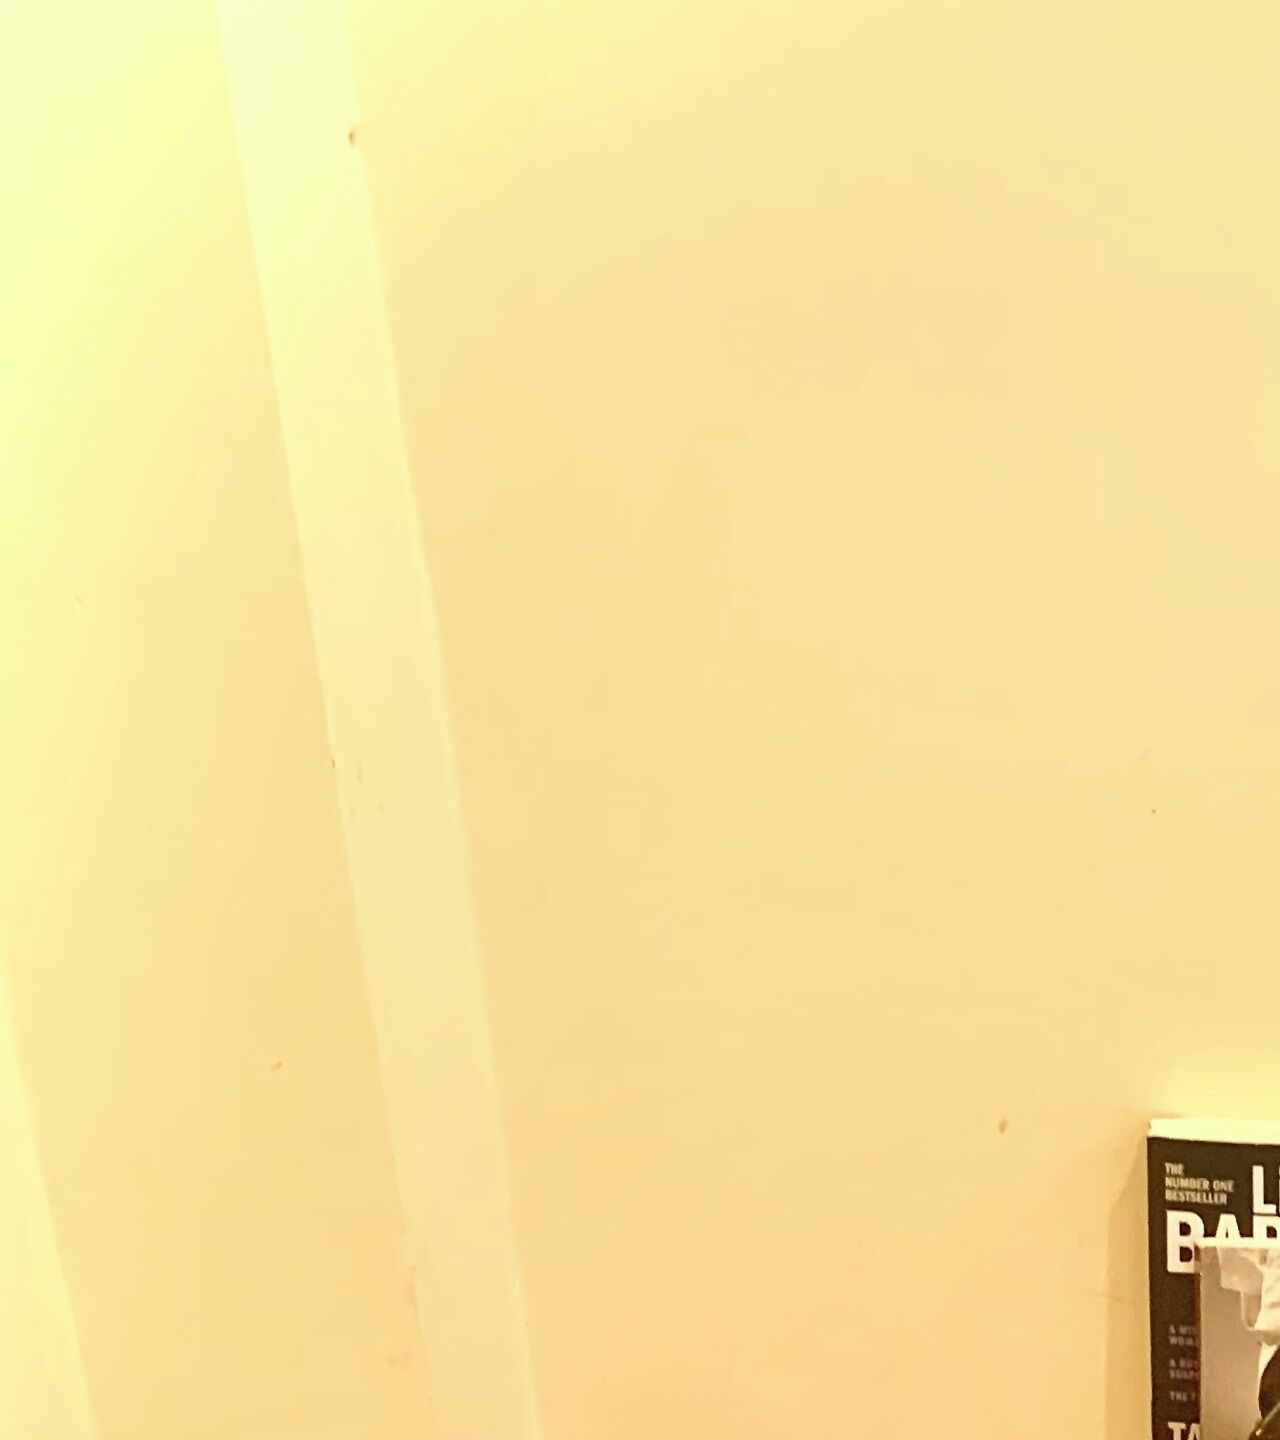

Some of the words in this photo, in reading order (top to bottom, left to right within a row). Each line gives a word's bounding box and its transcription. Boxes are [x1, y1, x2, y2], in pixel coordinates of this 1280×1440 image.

[1165, 1162, 1184, 1175] THE
[1165, 1177, 1209, 1191] NUMBER
[1212, 1180, 1234, 1193] ONE
[1165, 1188, 1228, 1205] BESTSELLER
